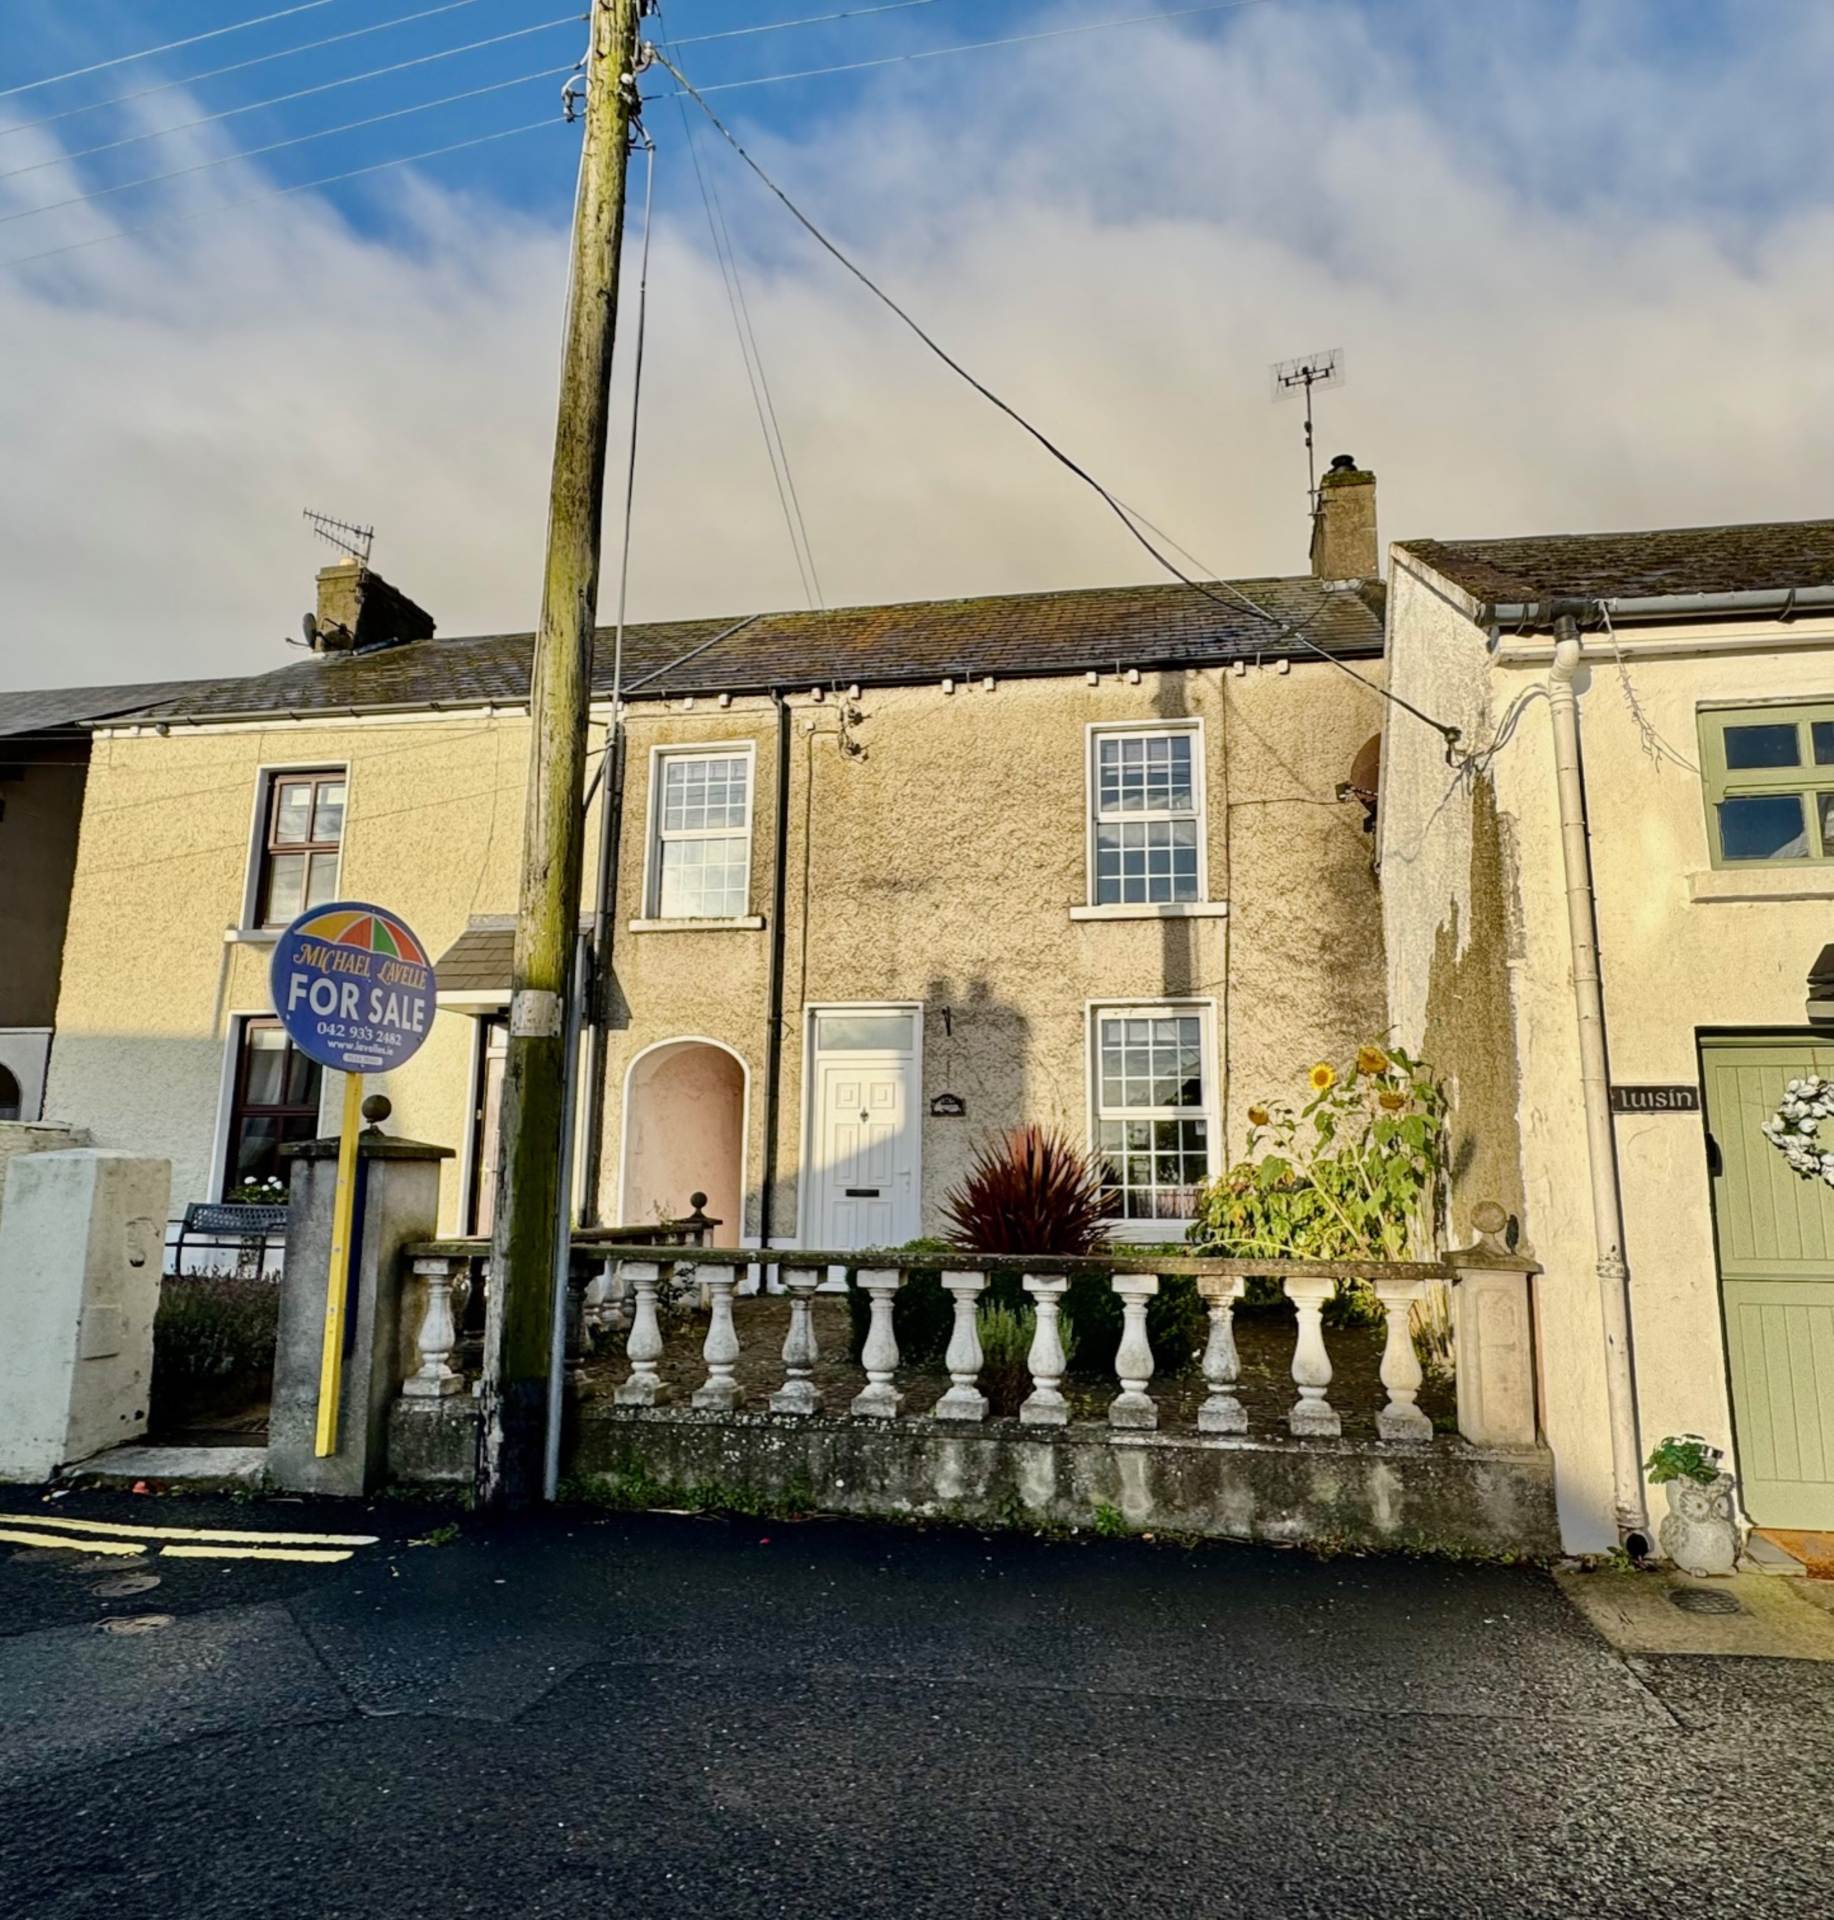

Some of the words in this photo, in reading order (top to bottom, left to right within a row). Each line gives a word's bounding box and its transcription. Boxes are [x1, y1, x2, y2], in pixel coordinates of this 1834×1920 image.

[293, 943, 371, 978] MICHAEL
[377, 960, 428, 990] LAVELLE
[287, 972, 360, 1021] FOR
[368, 988, 425, 1033] SALE
[316, 1021, 345, 1037] 042
[349, 1026, 373, 1041] 933
